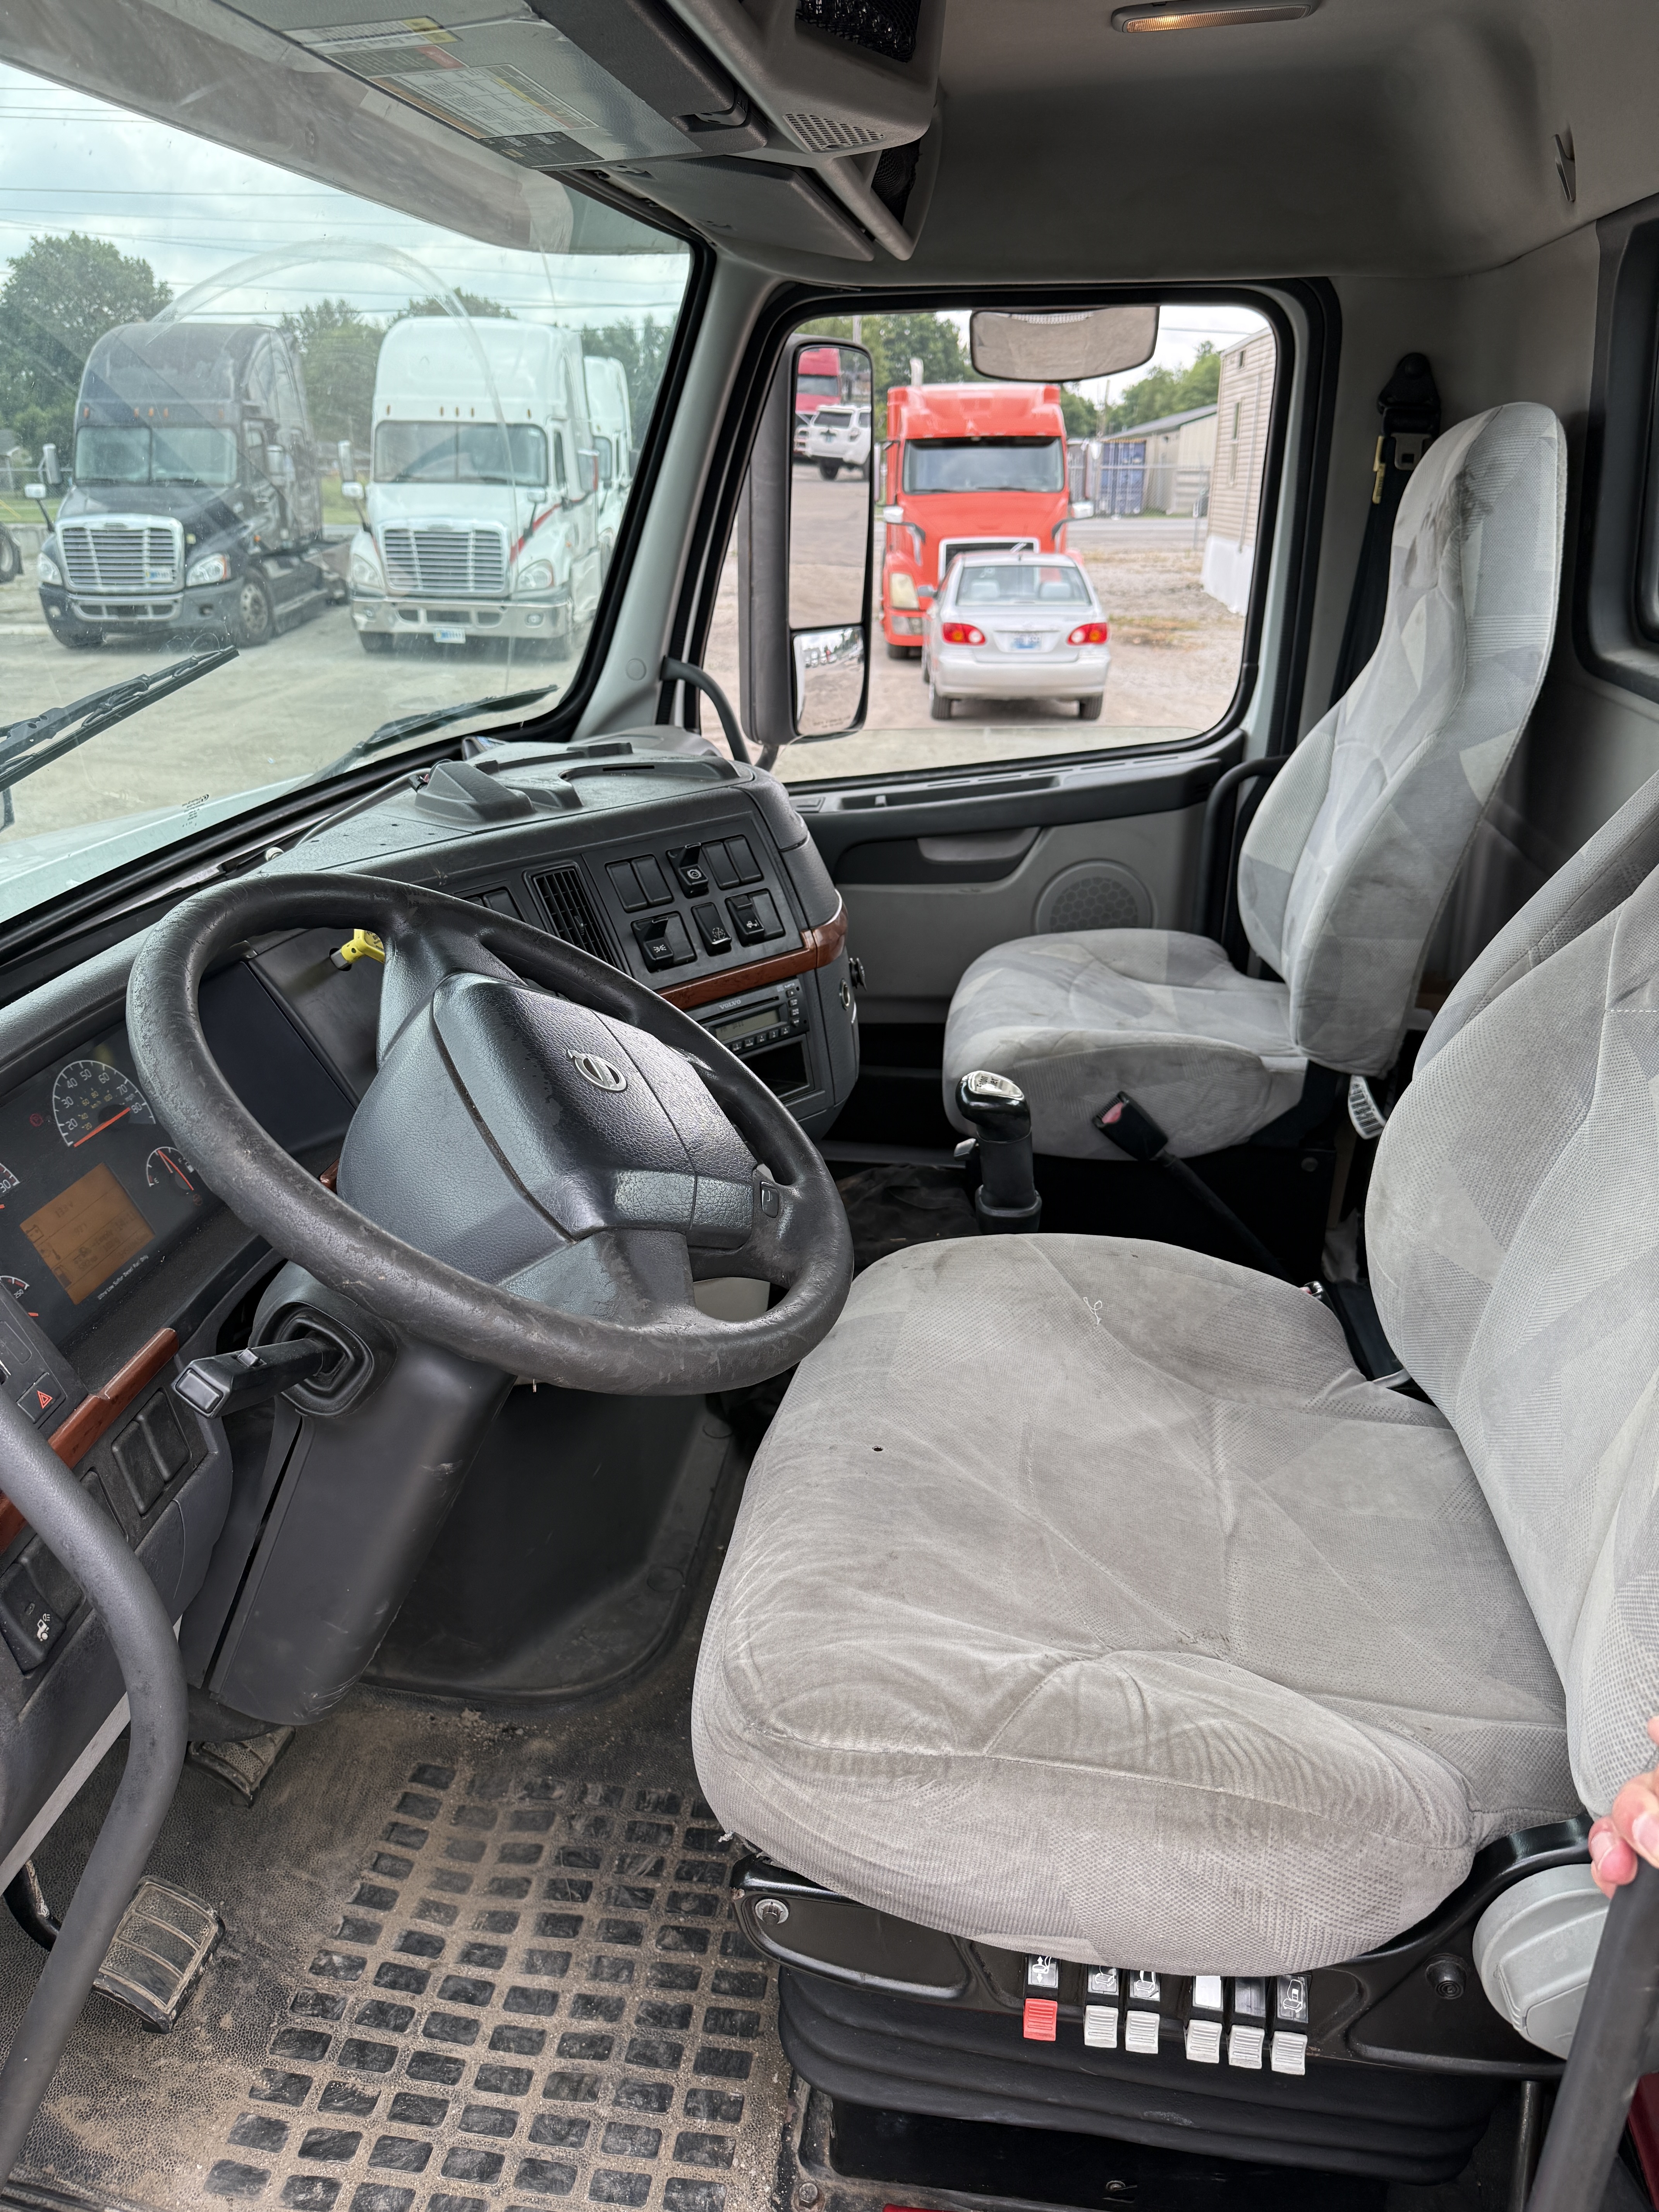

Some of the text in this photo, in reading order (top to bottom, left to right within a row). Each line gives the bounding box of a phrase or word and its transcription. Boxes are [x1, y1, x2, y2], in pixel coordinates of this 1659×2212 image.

[719, 999, 741, 1010] VOLVO
[80, 1069, 92, 1080] 50
[98, 1072, 110, 1084] 60
[67, 1077, 78, 1089] 40
[116, 1084, 128, 1096] 70
[61, 1096, 74, 1109] 30
[131, 1102, 142, 1113] 80
[80, 1112, 89, 1120] 40
[65, 1118, 78, 1131] 20
[85, 1122, 93, 1131] 20
[0, 1179, 11, 1193] 30
